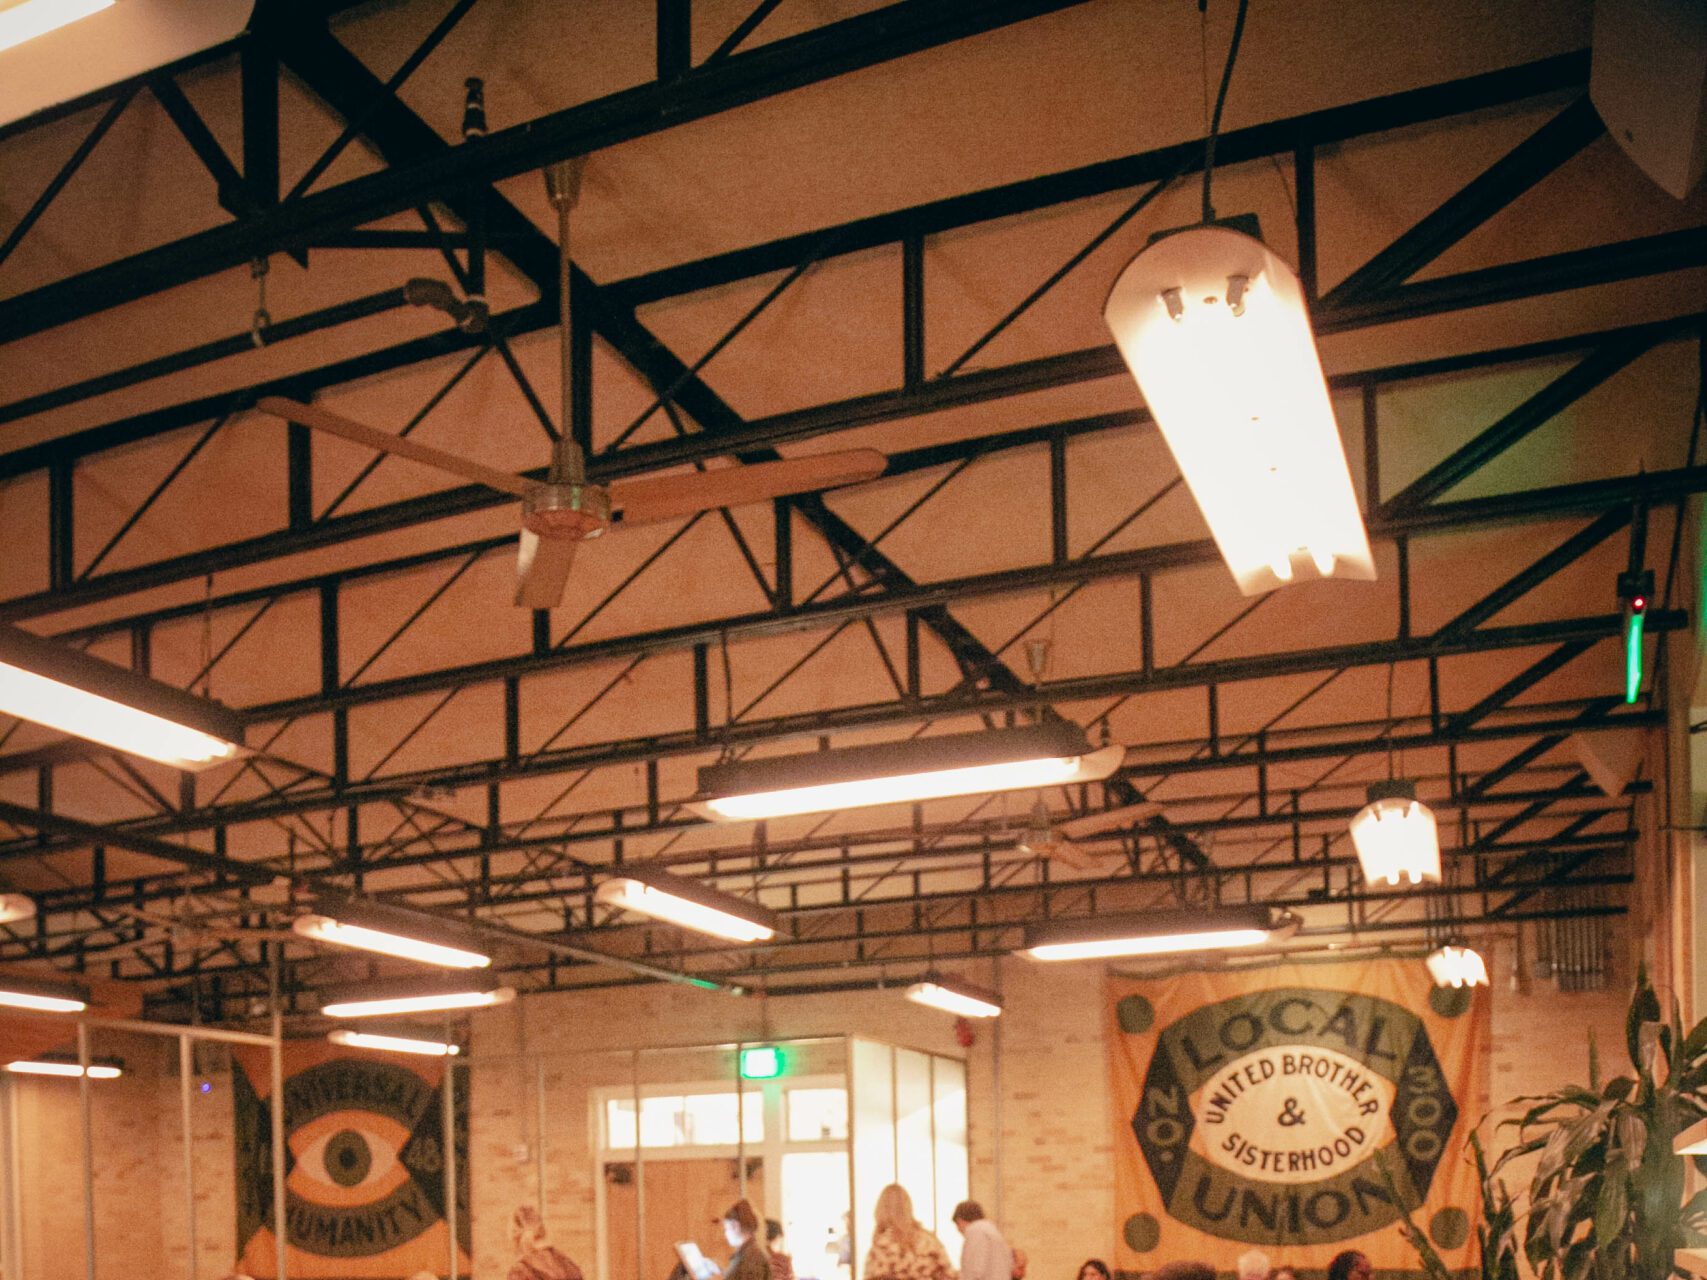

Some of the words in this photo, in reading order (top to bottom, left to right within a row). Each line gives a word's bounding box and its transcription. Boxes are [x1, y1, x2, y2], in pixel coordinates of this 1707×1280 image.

[1181, 998, 1397, 1069] LOCAL
[1205, 1057, 1275, 1126] UNITED
[1283, 1054, 1379, 1117] BROTHER
[1278, 1097, 1306, 1127] &
[1407, 1066, 1442, 1161] 300
[1221, 1127, 1367, 1172] SISTERHOOD
